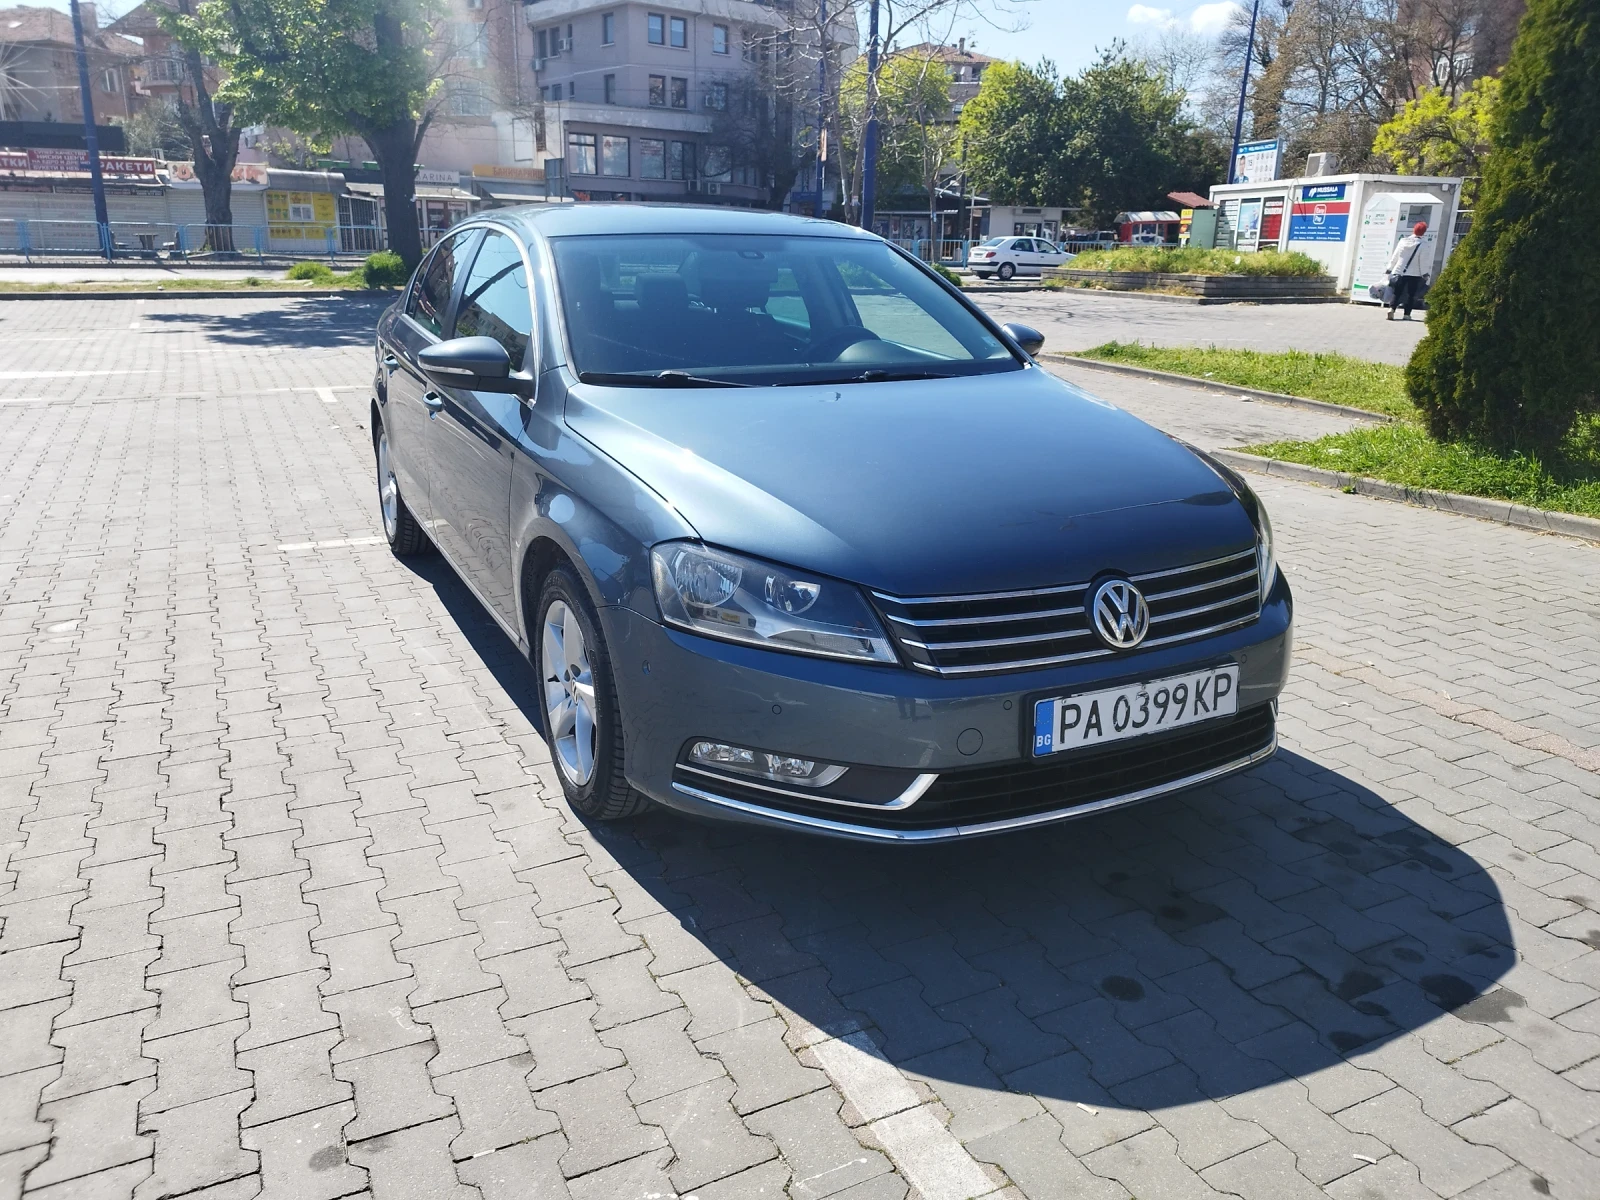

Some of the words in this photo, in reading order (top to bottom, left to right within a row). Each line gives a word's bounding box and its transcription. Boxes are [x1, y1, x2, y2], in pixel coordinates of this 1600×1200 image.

[0, 157, 27, 168] ТКИ
[492, 166, 545, 181] БАНИЧАРНИЦ
[1036, 734, 1051, 748] BG
